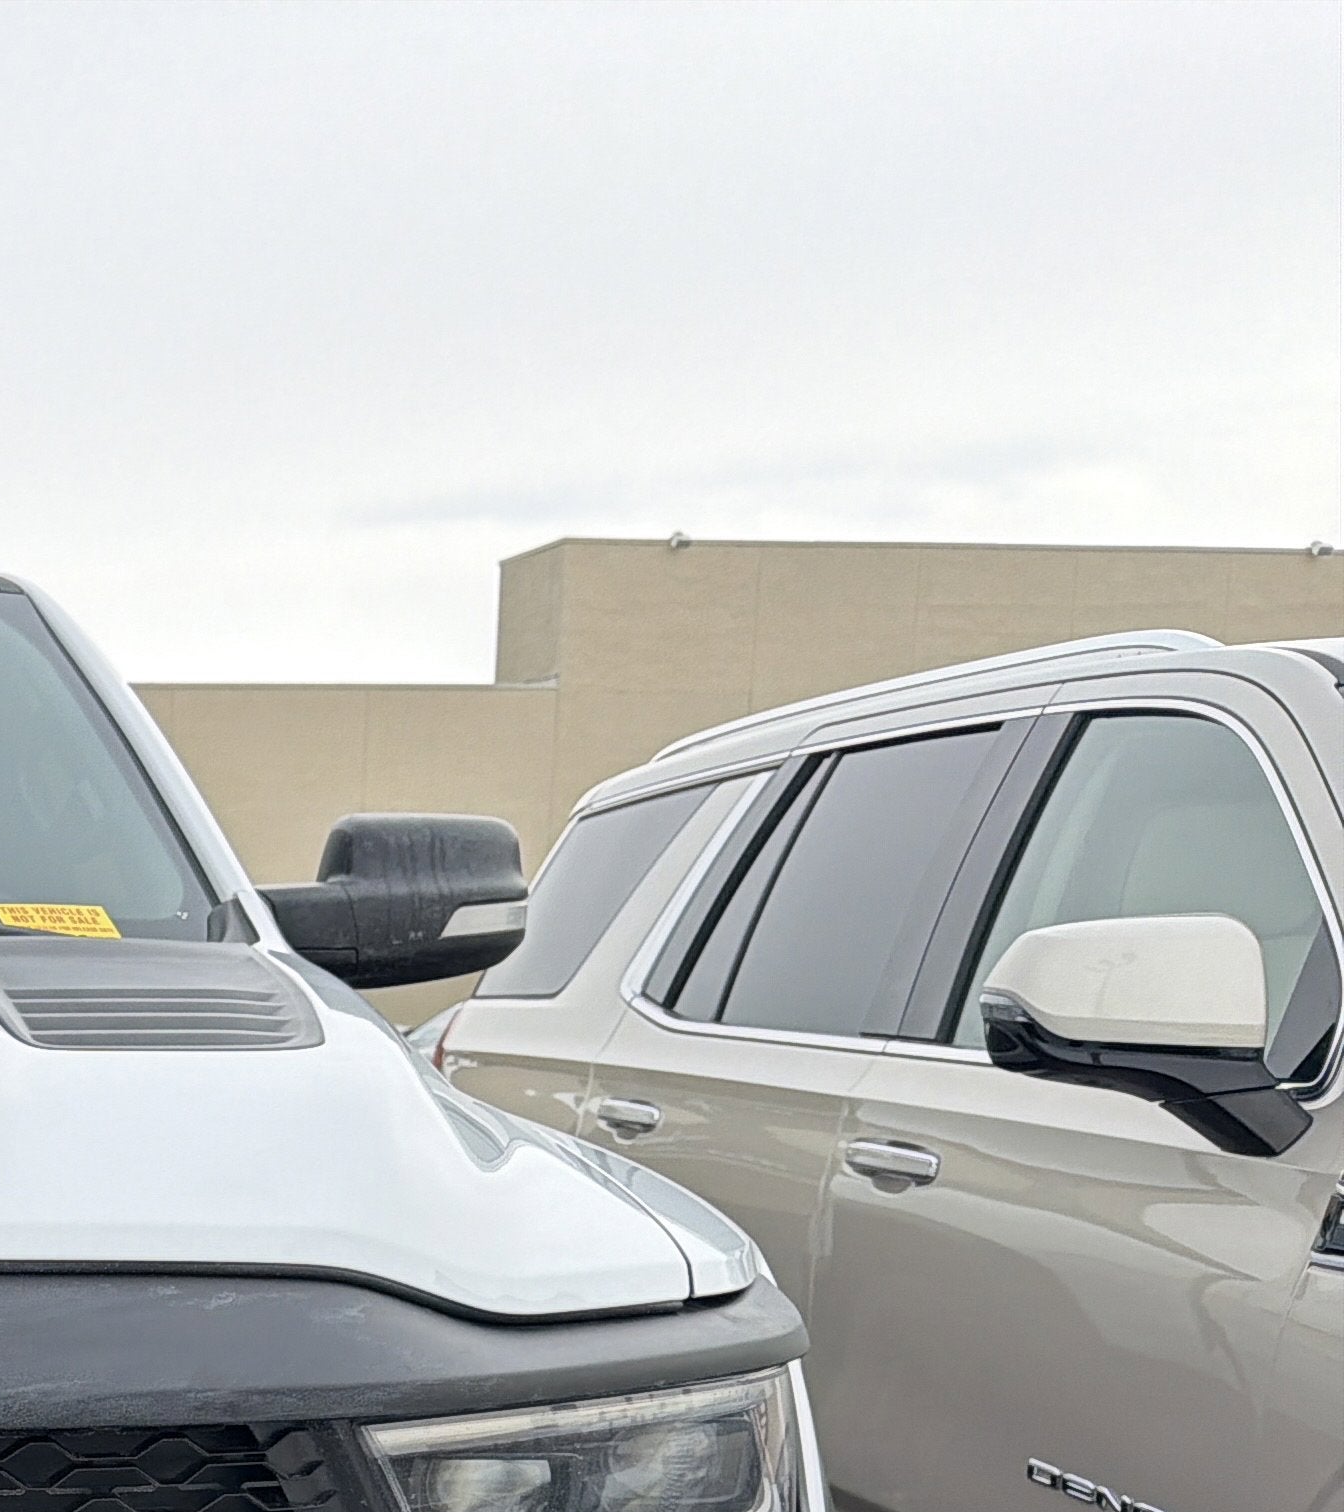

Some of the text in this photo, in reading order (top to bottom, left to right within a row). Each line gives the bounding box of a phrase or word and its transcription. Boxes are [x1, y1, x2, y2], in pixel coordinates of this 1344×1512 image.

[0, 906, 101, 917] THIS VEHICLE IS
[11, 914, 99, 925] NOT FOR SALE
